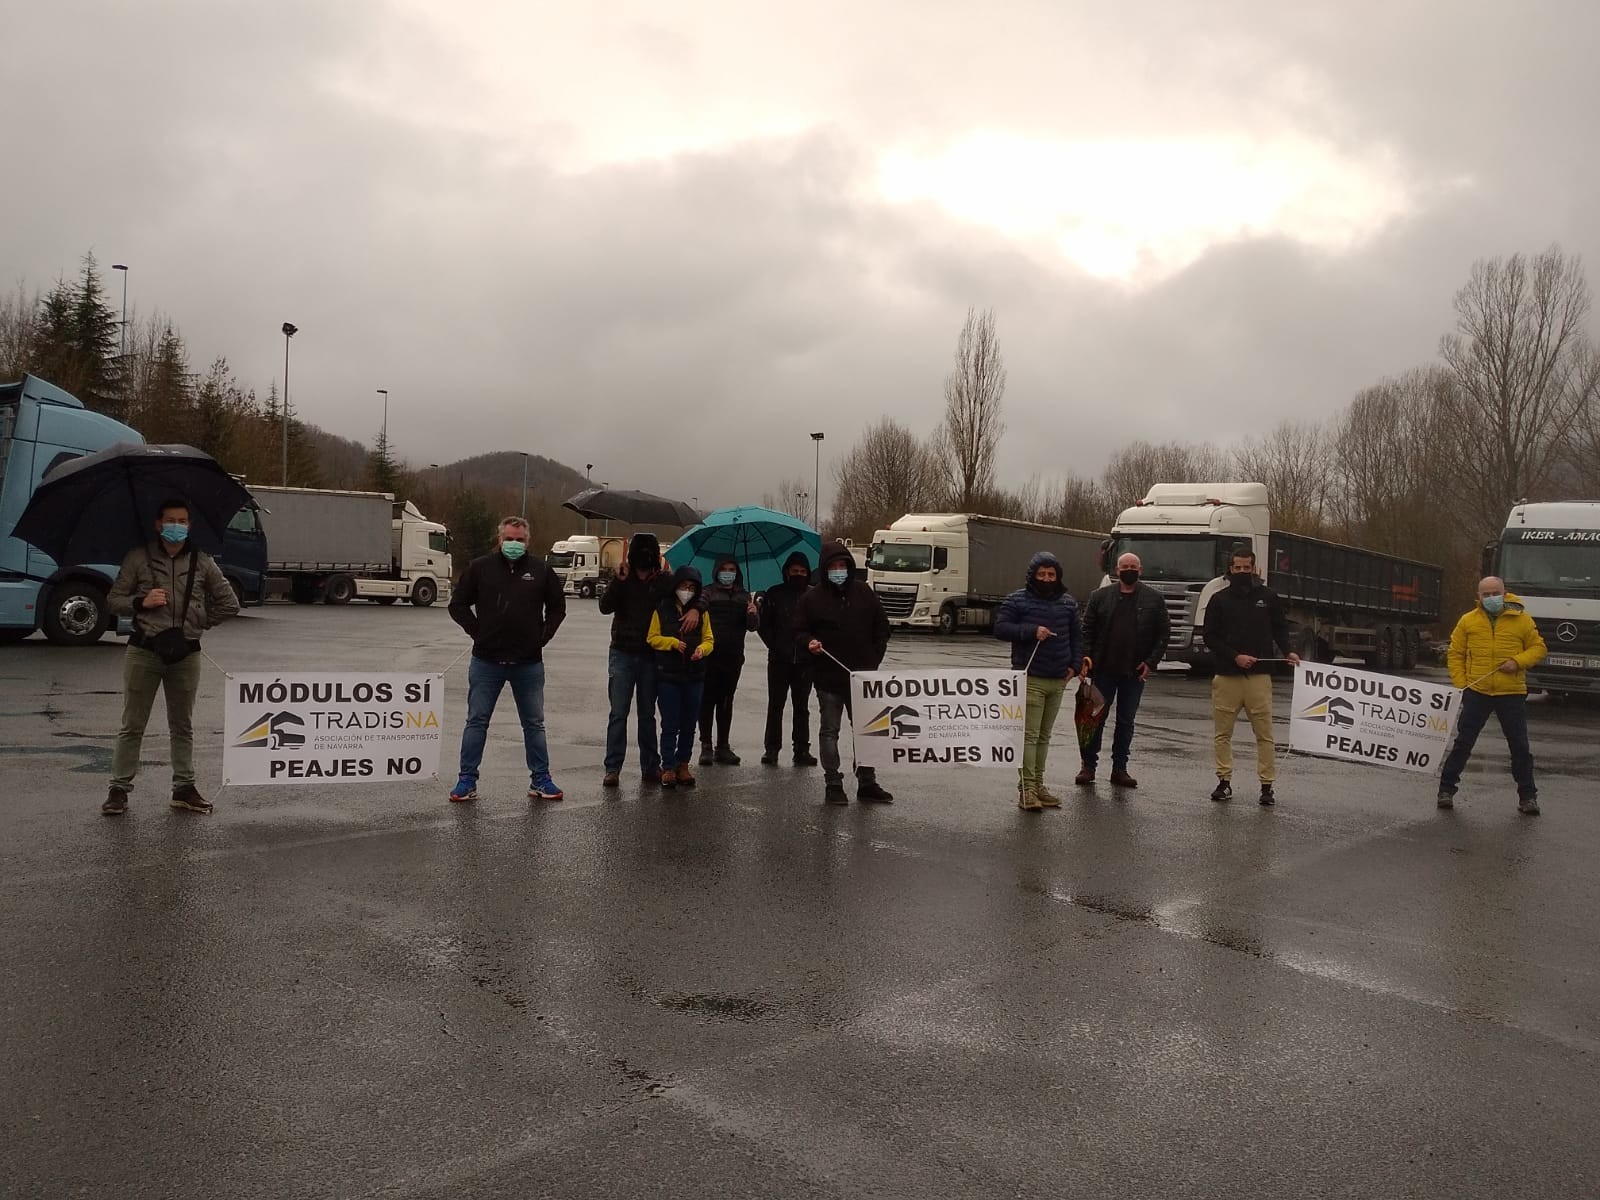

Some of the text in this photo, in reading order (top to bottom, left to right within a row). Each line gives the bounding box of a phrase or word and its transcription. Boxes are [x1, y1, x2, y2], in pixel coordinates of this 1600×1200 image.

[1521, 531, 1555, 540] IKER
[240, 678, 432, 704] MÓDULOS SÍ
[862, 675, 1018, 698] MÓDULOS SÍ
[1305, 670, 1452, 711] MÓDULOS SÍ
[892, 746, 1014, 763] PEAJES NO
[1326, 734, 1430, 768] PEAJES NO
[270, 757, 422, 778] PEAJES NO
